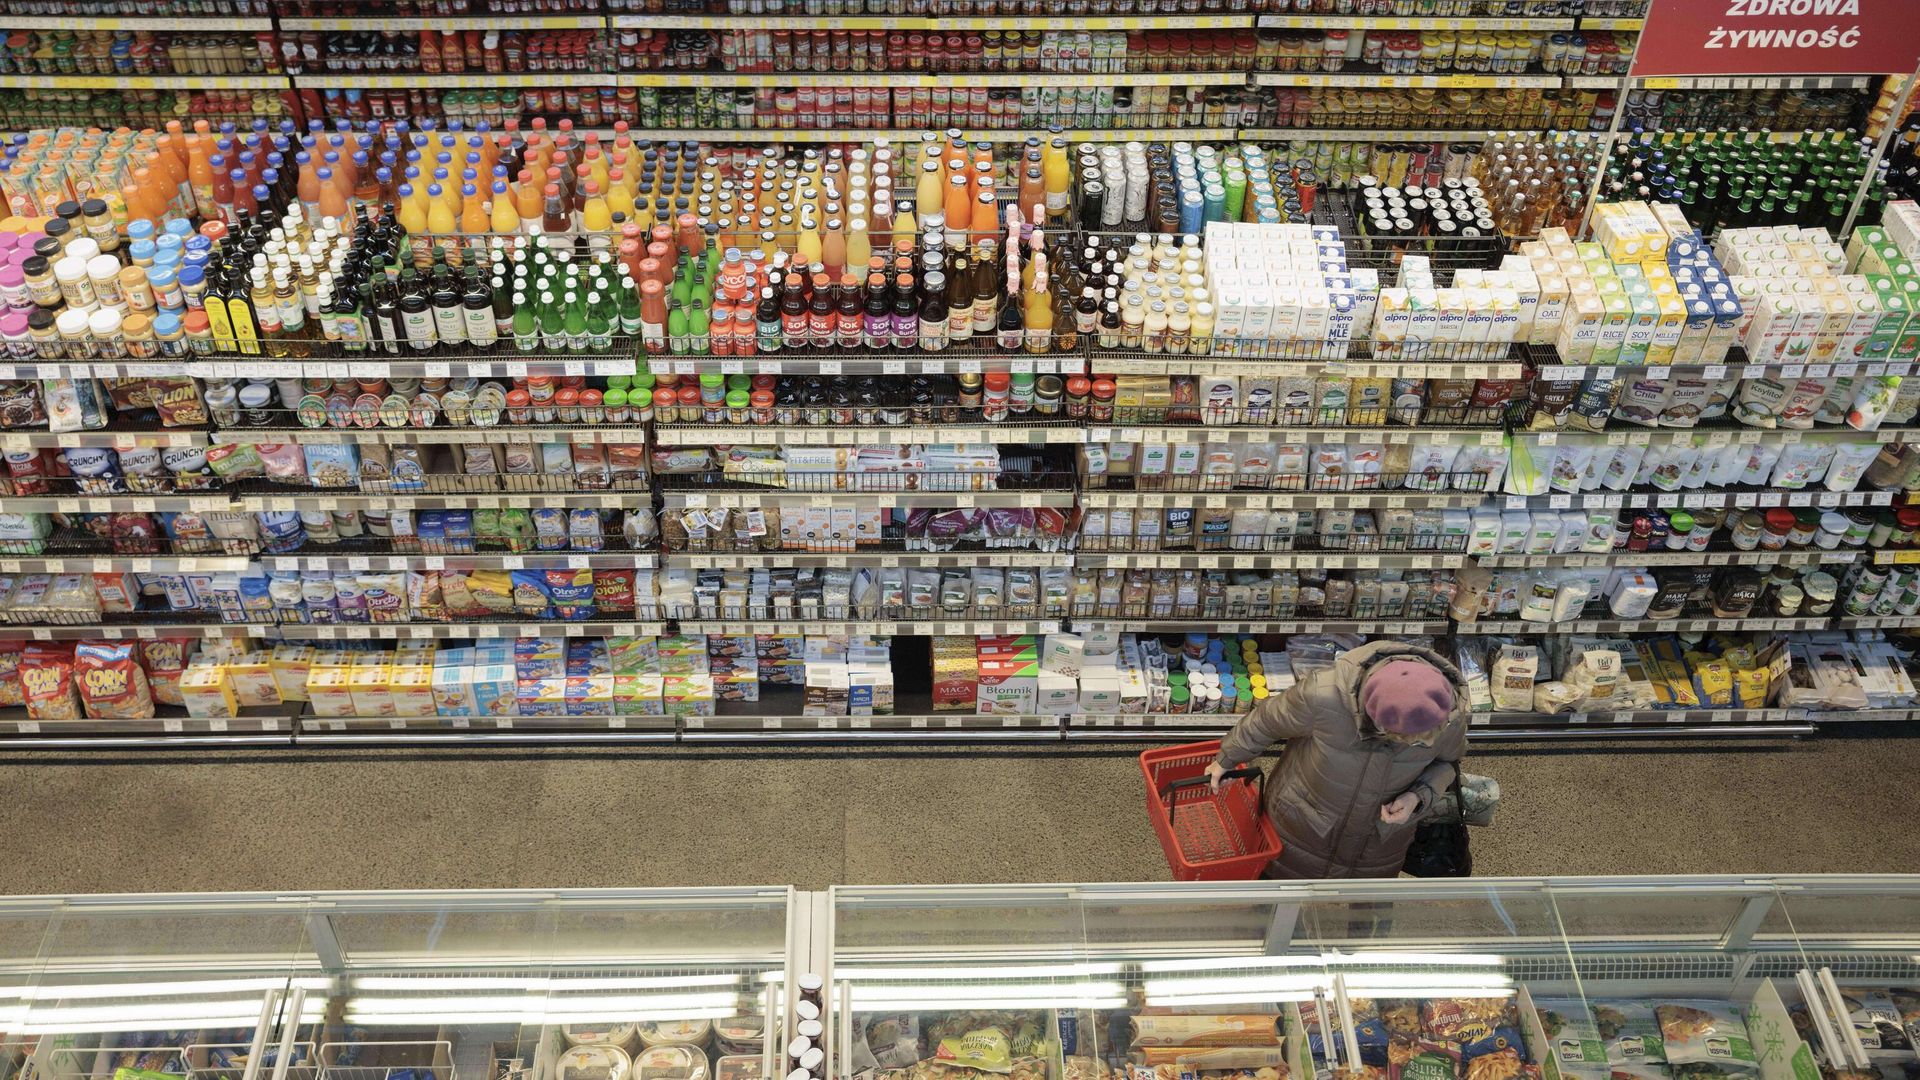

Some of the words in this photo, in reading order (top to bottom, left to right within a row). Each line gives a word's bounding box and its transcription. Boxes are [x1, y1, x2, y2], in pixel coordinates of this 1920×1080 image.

[1726, 0, 1859, 16] ZDROWA
[1704, 26, 1861, 48] ŻYWNOŚĆ
[1329, 314, 1353, 323] alpro
[1385, 314, 1408, 322] alpro
[1440, 313, 1463, 322] alpro
[1467, 314, 1490, 322] alpro
[1494, 314, 1517, 322] alpro
[761, 325, 778, 333] BIO
[788, 320, 806, 328] SOK
[810, 320, 827, 328] SOK
[839, 321, 857, 329] SOK
[872, 320, 890, 329] SOK
[898, 320, 916, 330] SOK
[1577, 330, 1595, 338] OAT
[163, 385, 194, 403] LION
[1634, 390, 1656, 399] Chia
[1751, 384, 1783, 399] Ksylitol
[1793, 395, 1814, 405] Goji
[68, 454, 104, 467] CRUNCHY
[120, 453, 157, 467] CRUNCHY
[164, 447, 204, 466] CRUNCHY
[216, 452, 255, 472] muesli
[1170, 511, 1190, 521] BIO
[23, 666, 61, 687] CORN
[85, 668, 128, 687] CORN
[940, 686, 971, 694] MACA
[986, 686, 1032, 694] Błonnik
[1428, 1013, 1462, 1029] Original
[1457, 1027, 1486, 1039] AVIKO
[1409, 1060, 1444, 1075] FRITES
